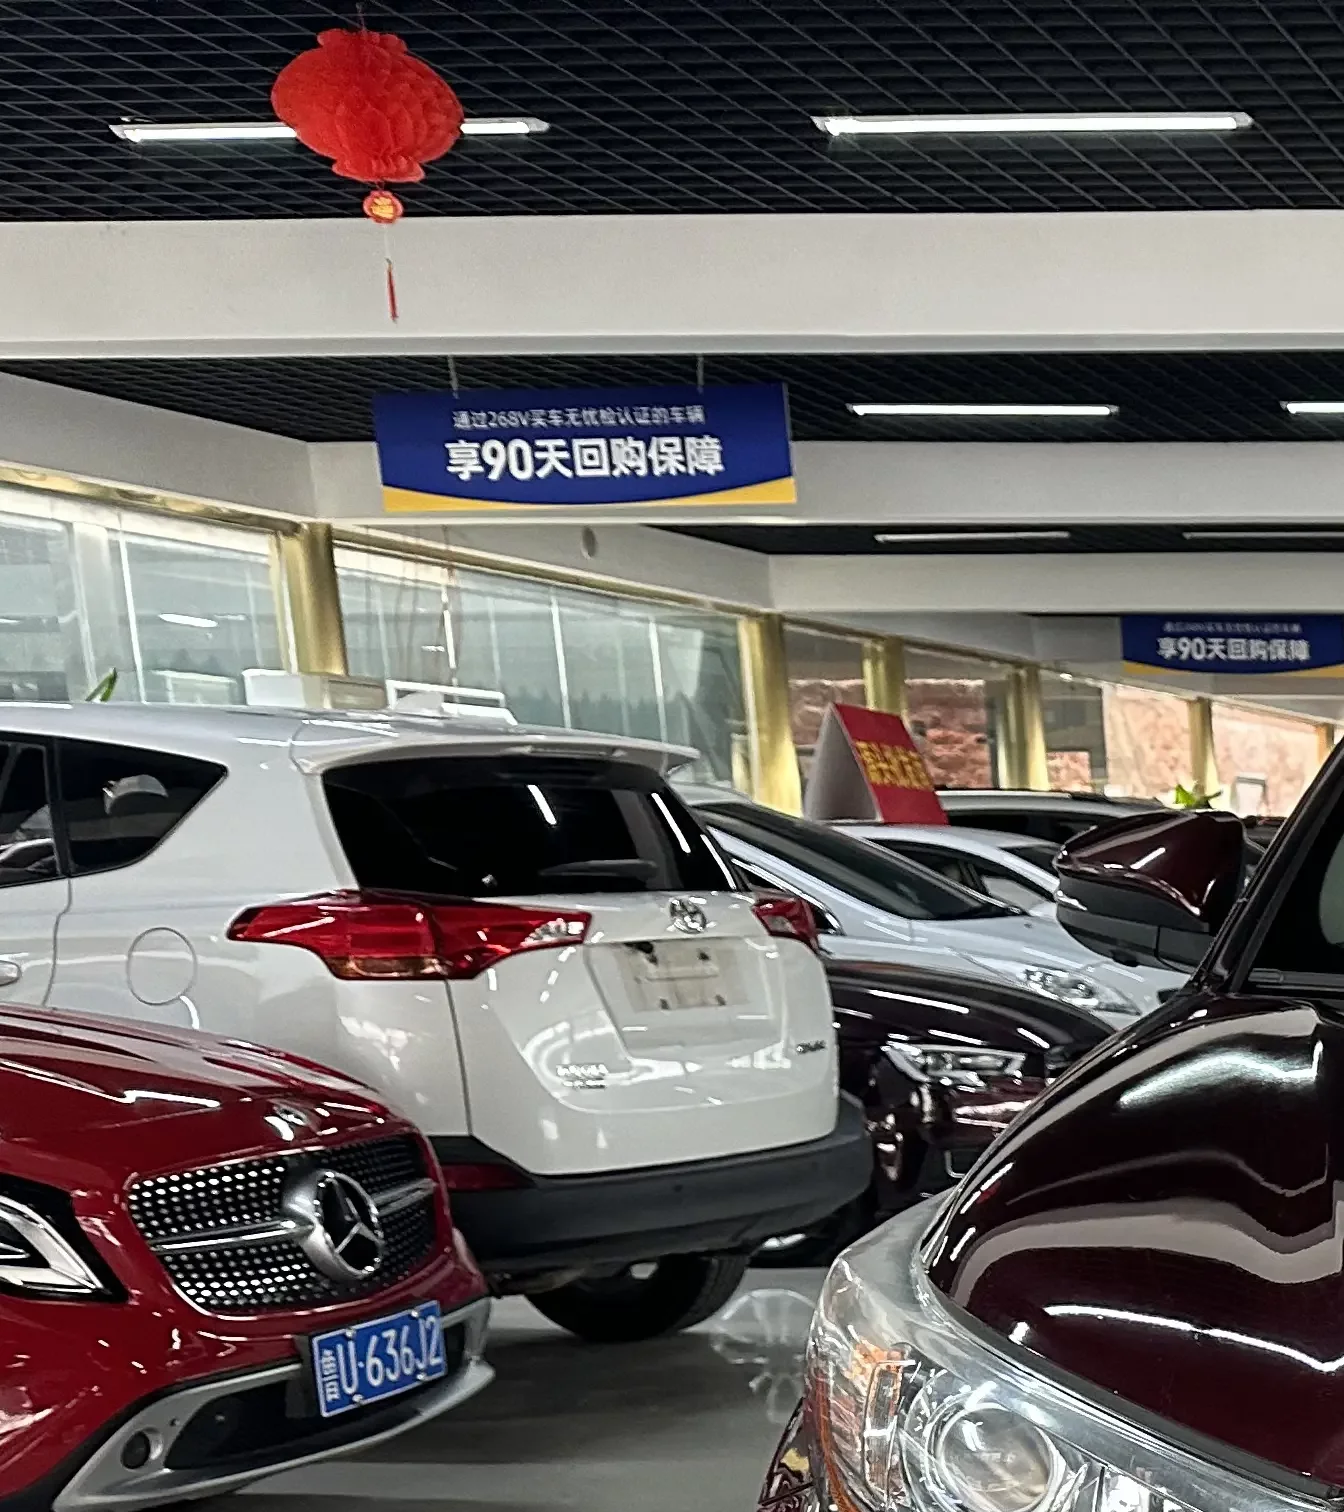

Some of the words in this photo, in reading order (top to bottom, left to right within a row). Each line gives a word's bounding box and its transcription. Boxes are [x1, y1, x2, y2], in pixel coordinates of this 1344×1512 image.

[445, 435, 725, 480] 享90天回购保障
